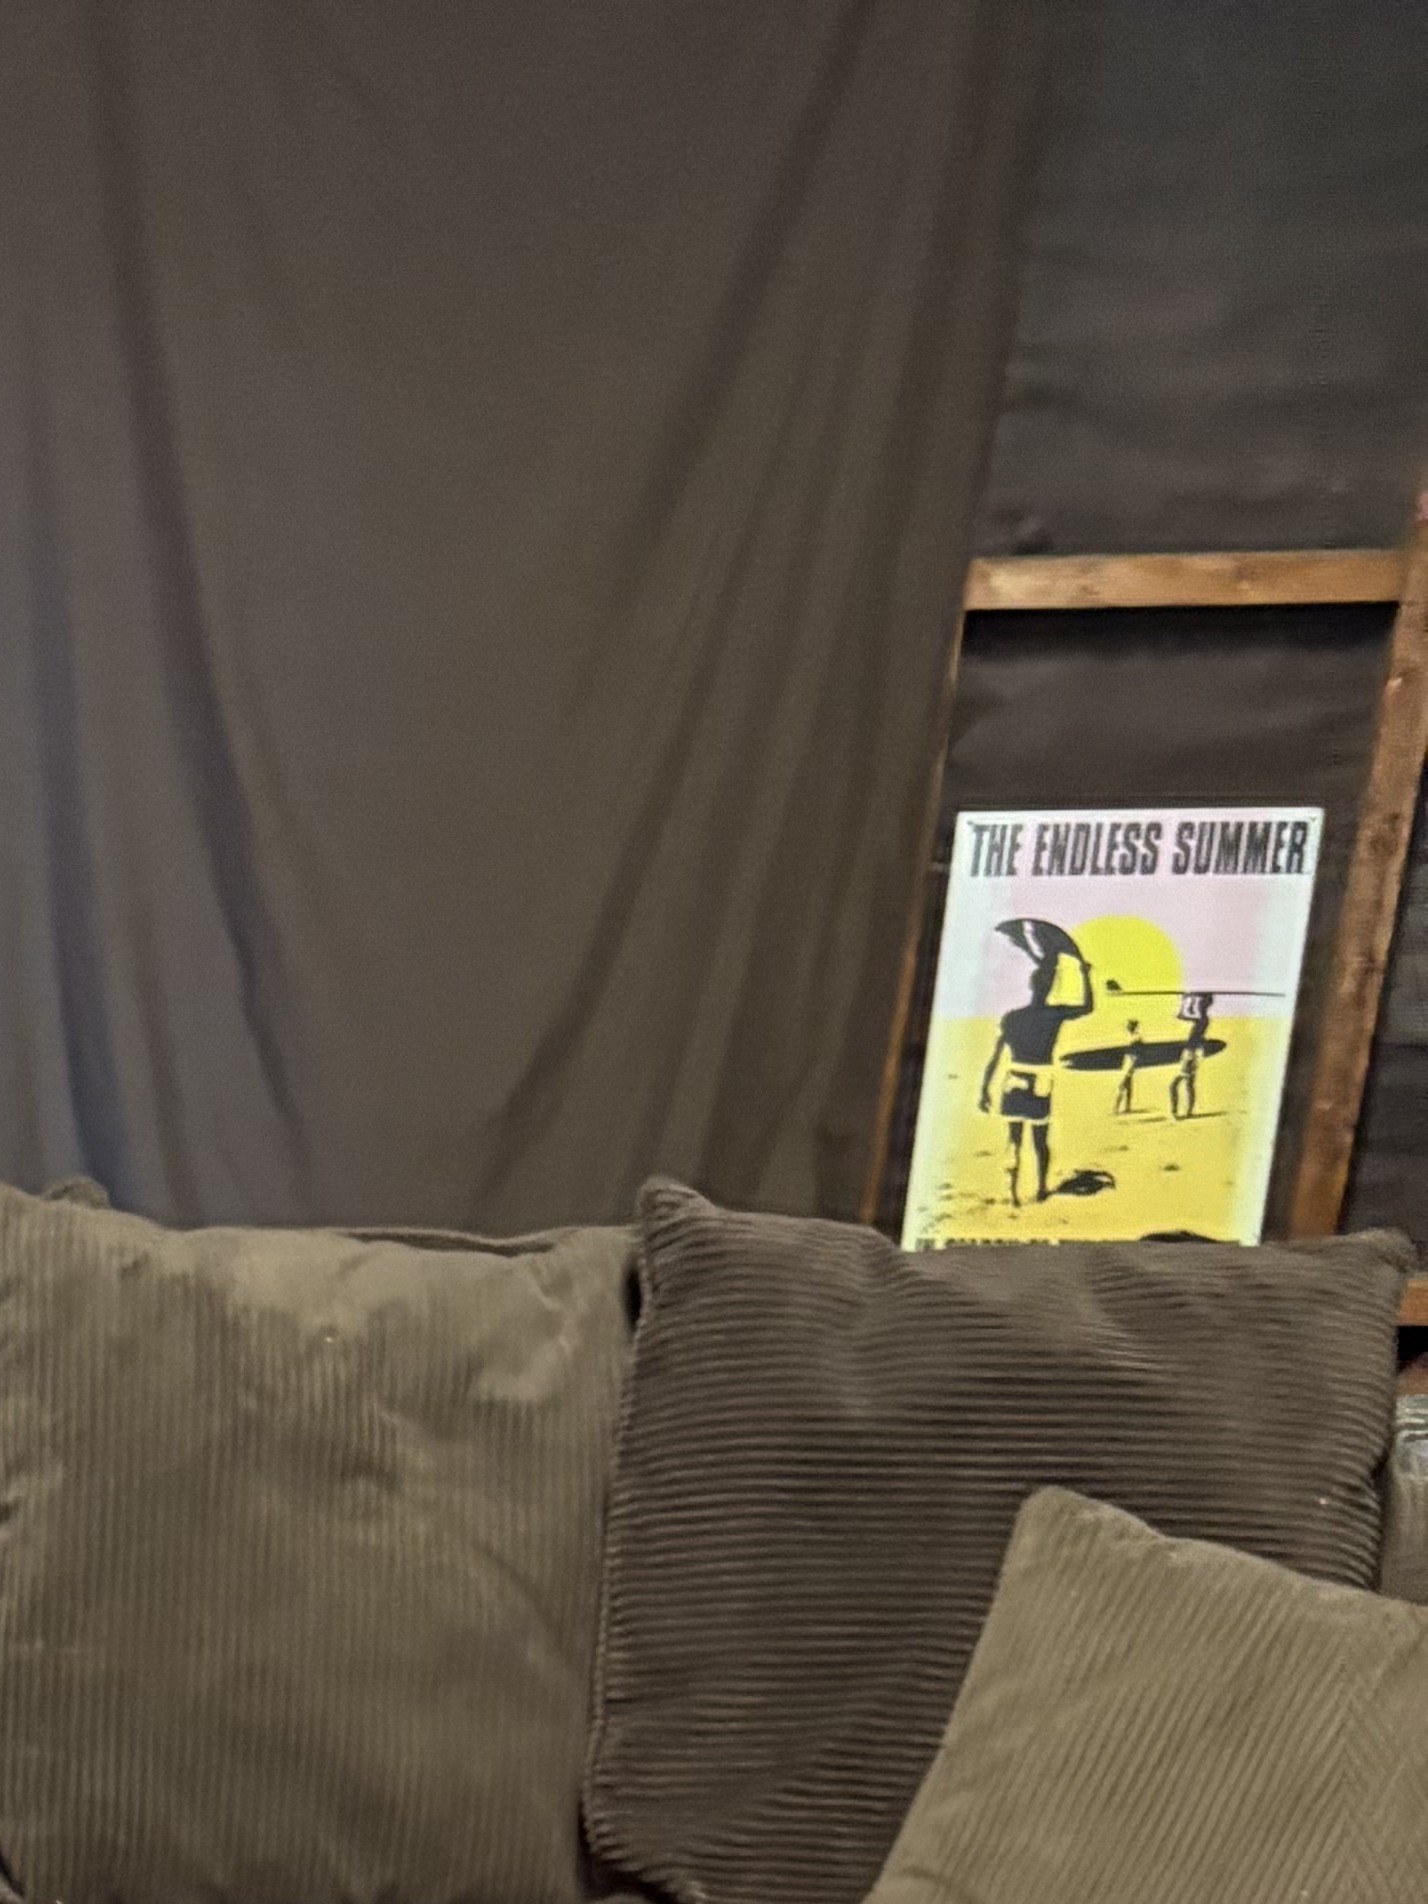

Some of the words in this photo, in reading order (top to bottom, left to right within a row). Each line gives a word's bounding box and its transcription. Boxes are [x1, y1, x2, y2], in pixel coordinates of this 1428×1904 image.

[970, 823, 1024, 877] THE
[1031, 822, 1163, 877] ENDLESS
[1171, 820, 1309, 875] SUMMER
